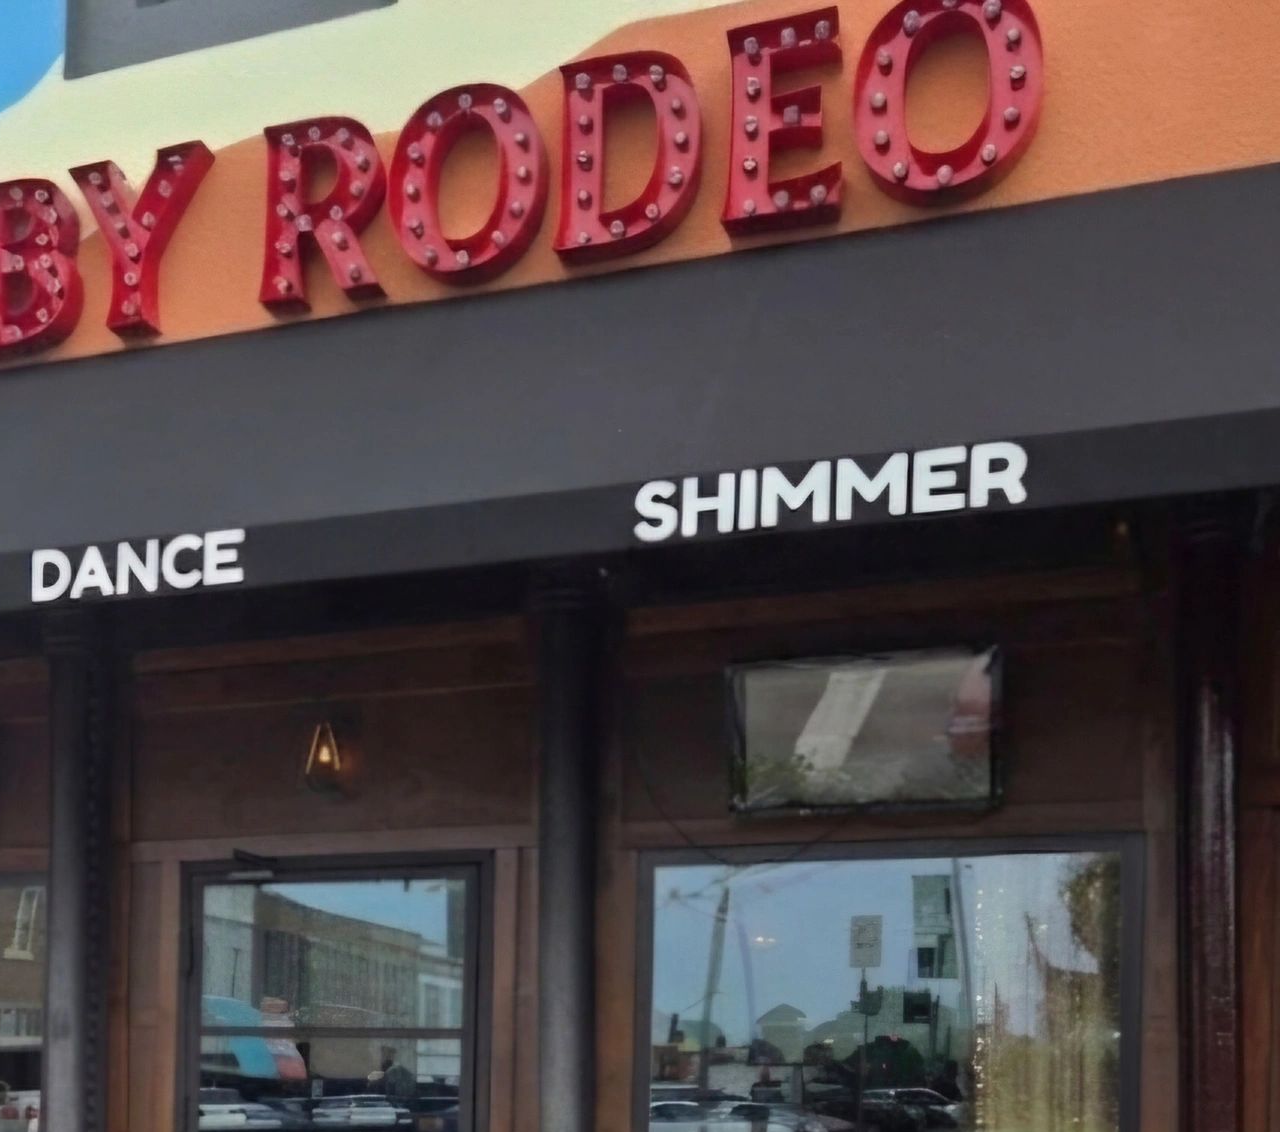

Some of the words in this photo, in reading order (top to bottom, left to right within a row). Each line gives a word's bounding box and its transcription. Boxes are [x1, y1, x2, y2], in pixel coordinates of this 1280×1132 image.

[258, 0, 1045, 312] RODEO
[634, 442, 1028, 542] SHIMMER
[31, 528, 246, 603] DANCE
